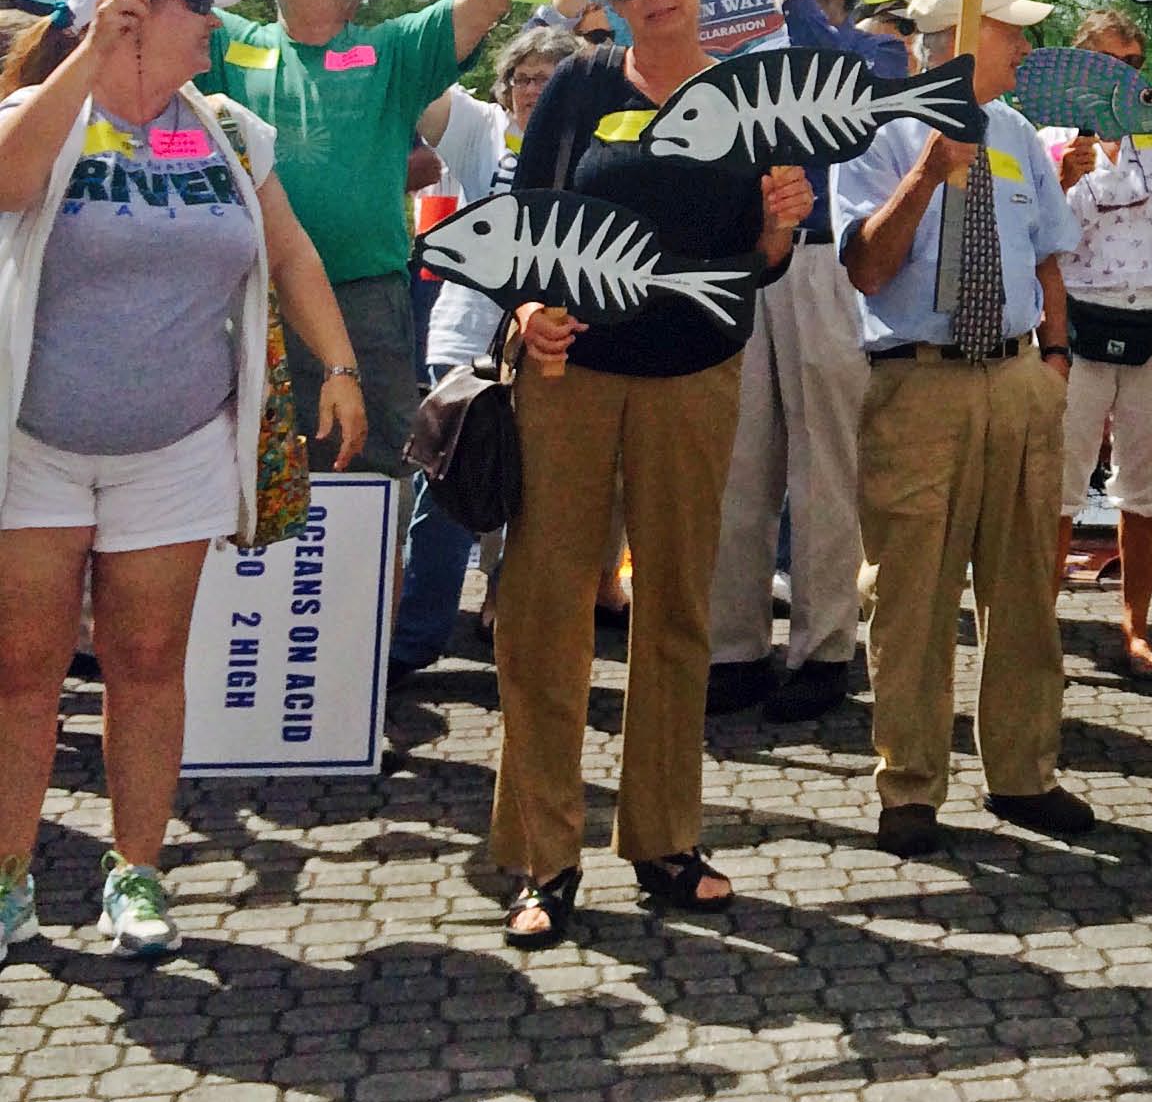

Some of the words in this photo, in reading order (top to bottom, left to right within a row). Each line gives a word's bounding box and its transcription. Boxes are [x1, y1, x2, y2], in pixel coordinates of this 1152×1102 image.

[701, 19, 766, 41] CLARATION
[290, 505, 328, 616] OCEANS
[232, 611, 262, 628] 2
[286, 626, 320, 664] ON
[224, 639, 260, 709] HIGH
[282, 673, 317, 743] ACID
